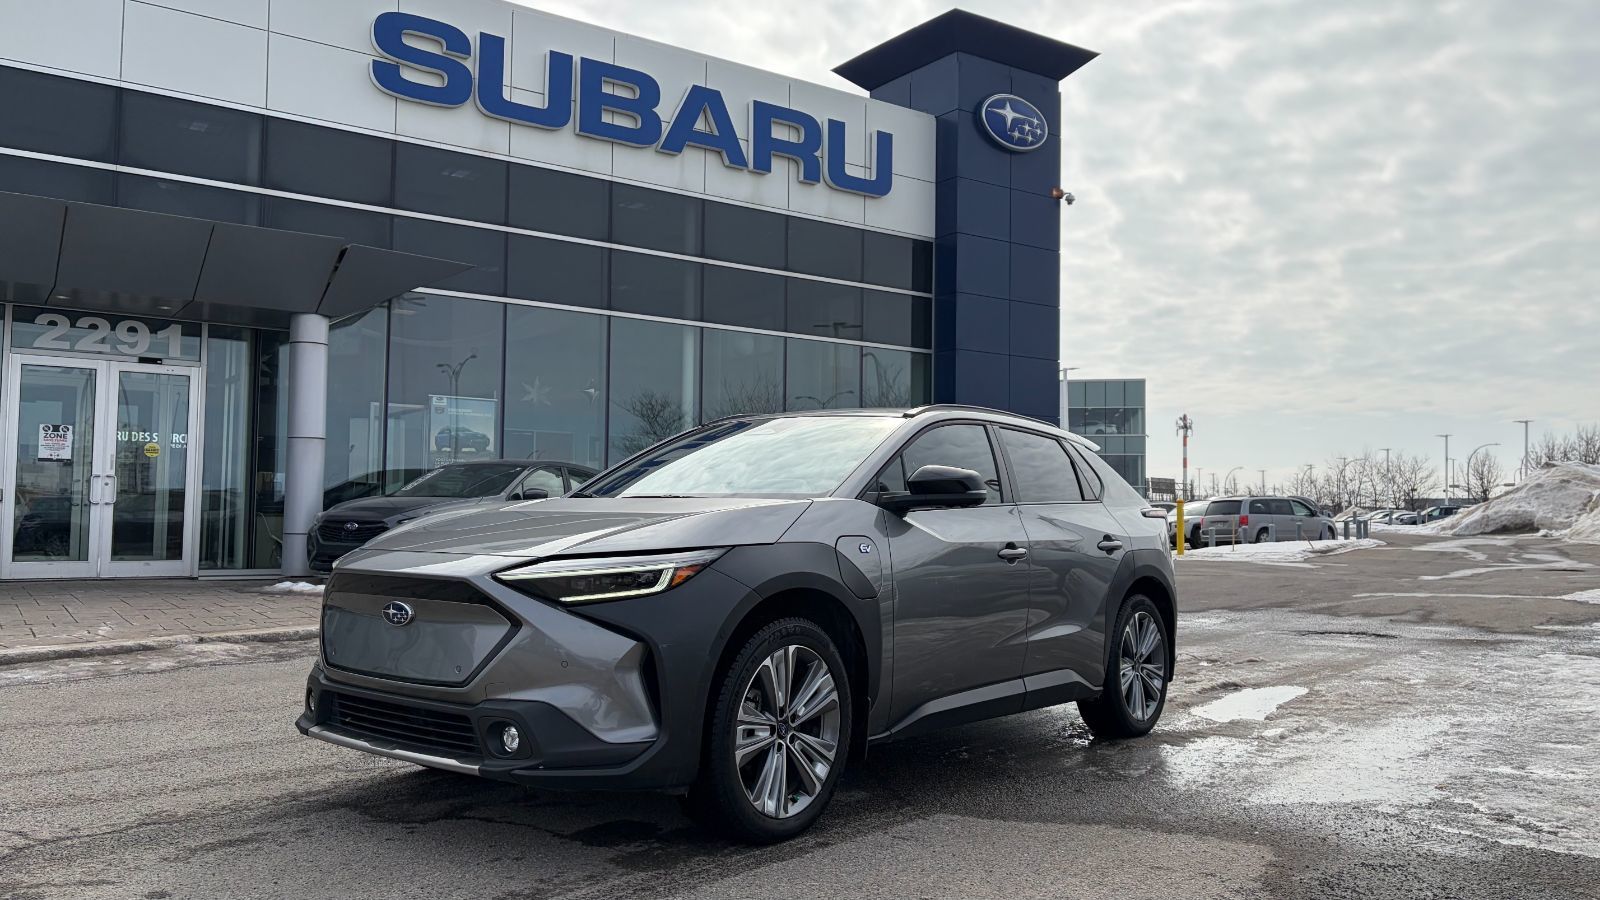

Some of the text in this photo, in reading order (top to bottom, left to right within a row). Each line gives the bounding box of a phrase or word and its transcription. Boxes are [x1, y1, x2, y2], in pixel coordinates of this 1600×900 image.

[369, 11, 894, 198] SUBARU
[32, 313, 183, 358] 2291
[43, 432, 68, 440] ZONE
[131, 431, 151, 442] DES
[859, 543, 871, 553] EV
